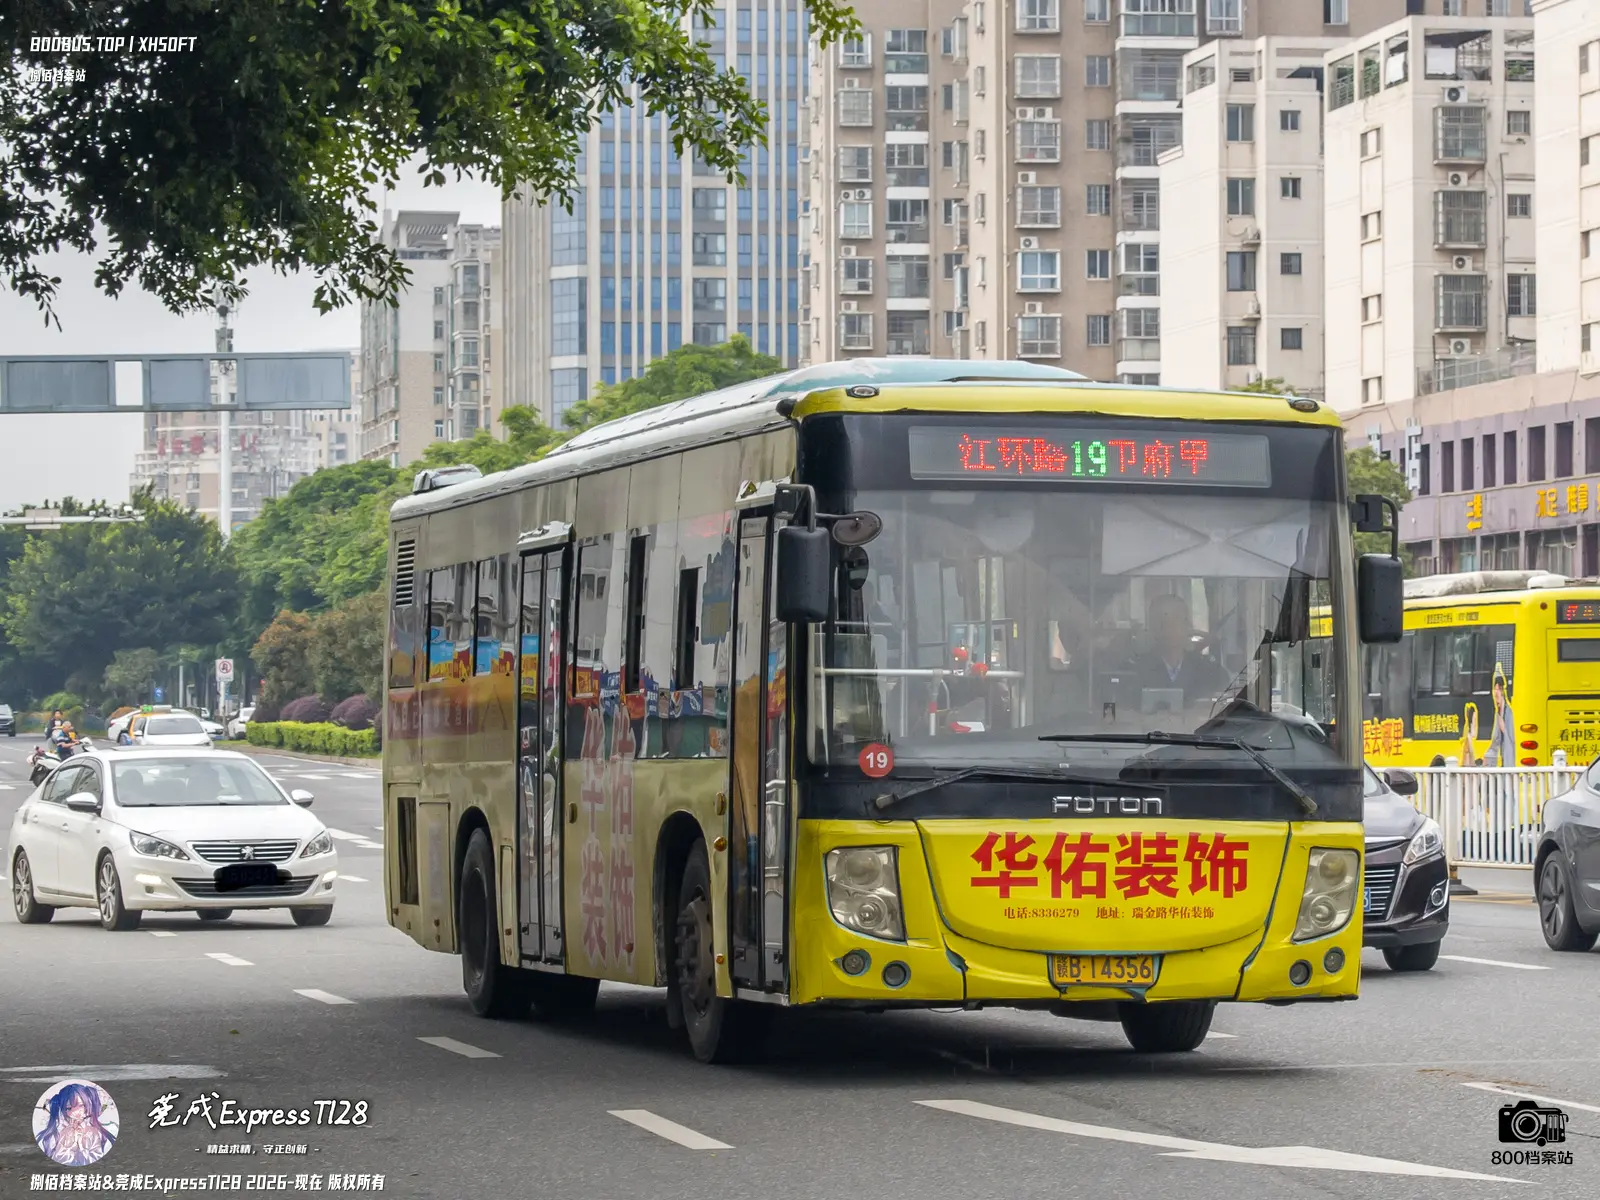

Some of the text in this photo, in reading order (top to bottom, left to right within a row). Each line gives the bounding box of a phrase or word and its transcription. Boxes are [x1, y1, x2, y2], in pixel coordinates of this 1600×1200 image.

[1070, 440, 1107, 477] 19
[865, 751, 888, 769] 19
[1051, 796, 1163, 815] FOTON
[970, 831, 1249, 899] 华佑装饰
